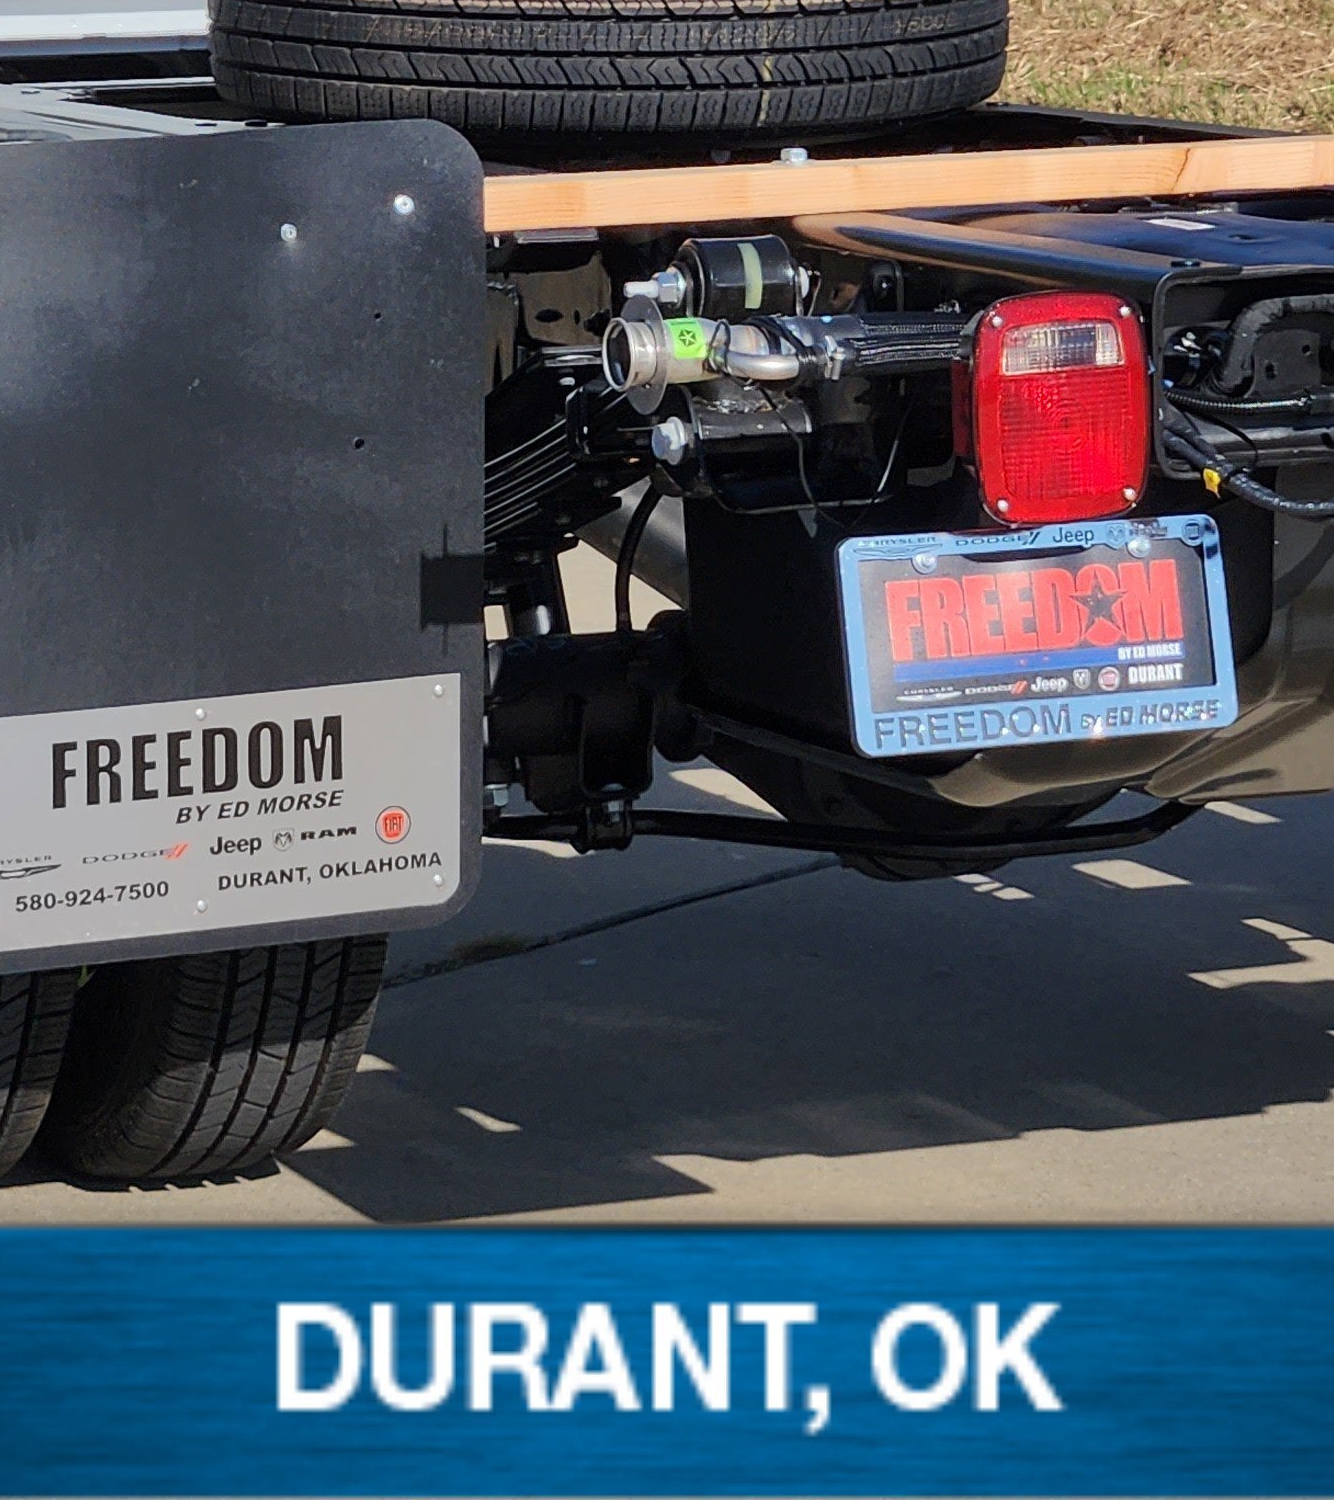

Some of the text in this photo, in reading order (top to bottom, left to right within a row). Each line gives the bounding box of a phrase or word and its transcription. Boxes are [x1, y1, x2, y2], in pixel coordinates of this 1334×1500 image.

[1052, 527, 1095, 545] Jeep
[884, 558, 1185, 662] FREEDOM
[1117, 642, 1182, 661] BY ED MORSE
[1030, 676, 1069, 693] Jeep
[1127, 662, 1184, 685] DURANT
[873, 703, 1072, 750] FREEDOM
[1105, 706, 1133, 727] ED
[1139, 698, 1219, 725] MORSE
[50, 714, 344, 810] FREEDOM
[175, 789, 345, 825] BY ED MORSE
[81, 847, 173, 865] DODGE
[209, 833, 262, 858] Jeep
[300, 825, 358, 841] RAM
[383, 815, 403, 833] FIAT
[217, 851, 442, 891] DURANT, OKLAHOMA
[15, 880, 170, 913] 580-924-7500
